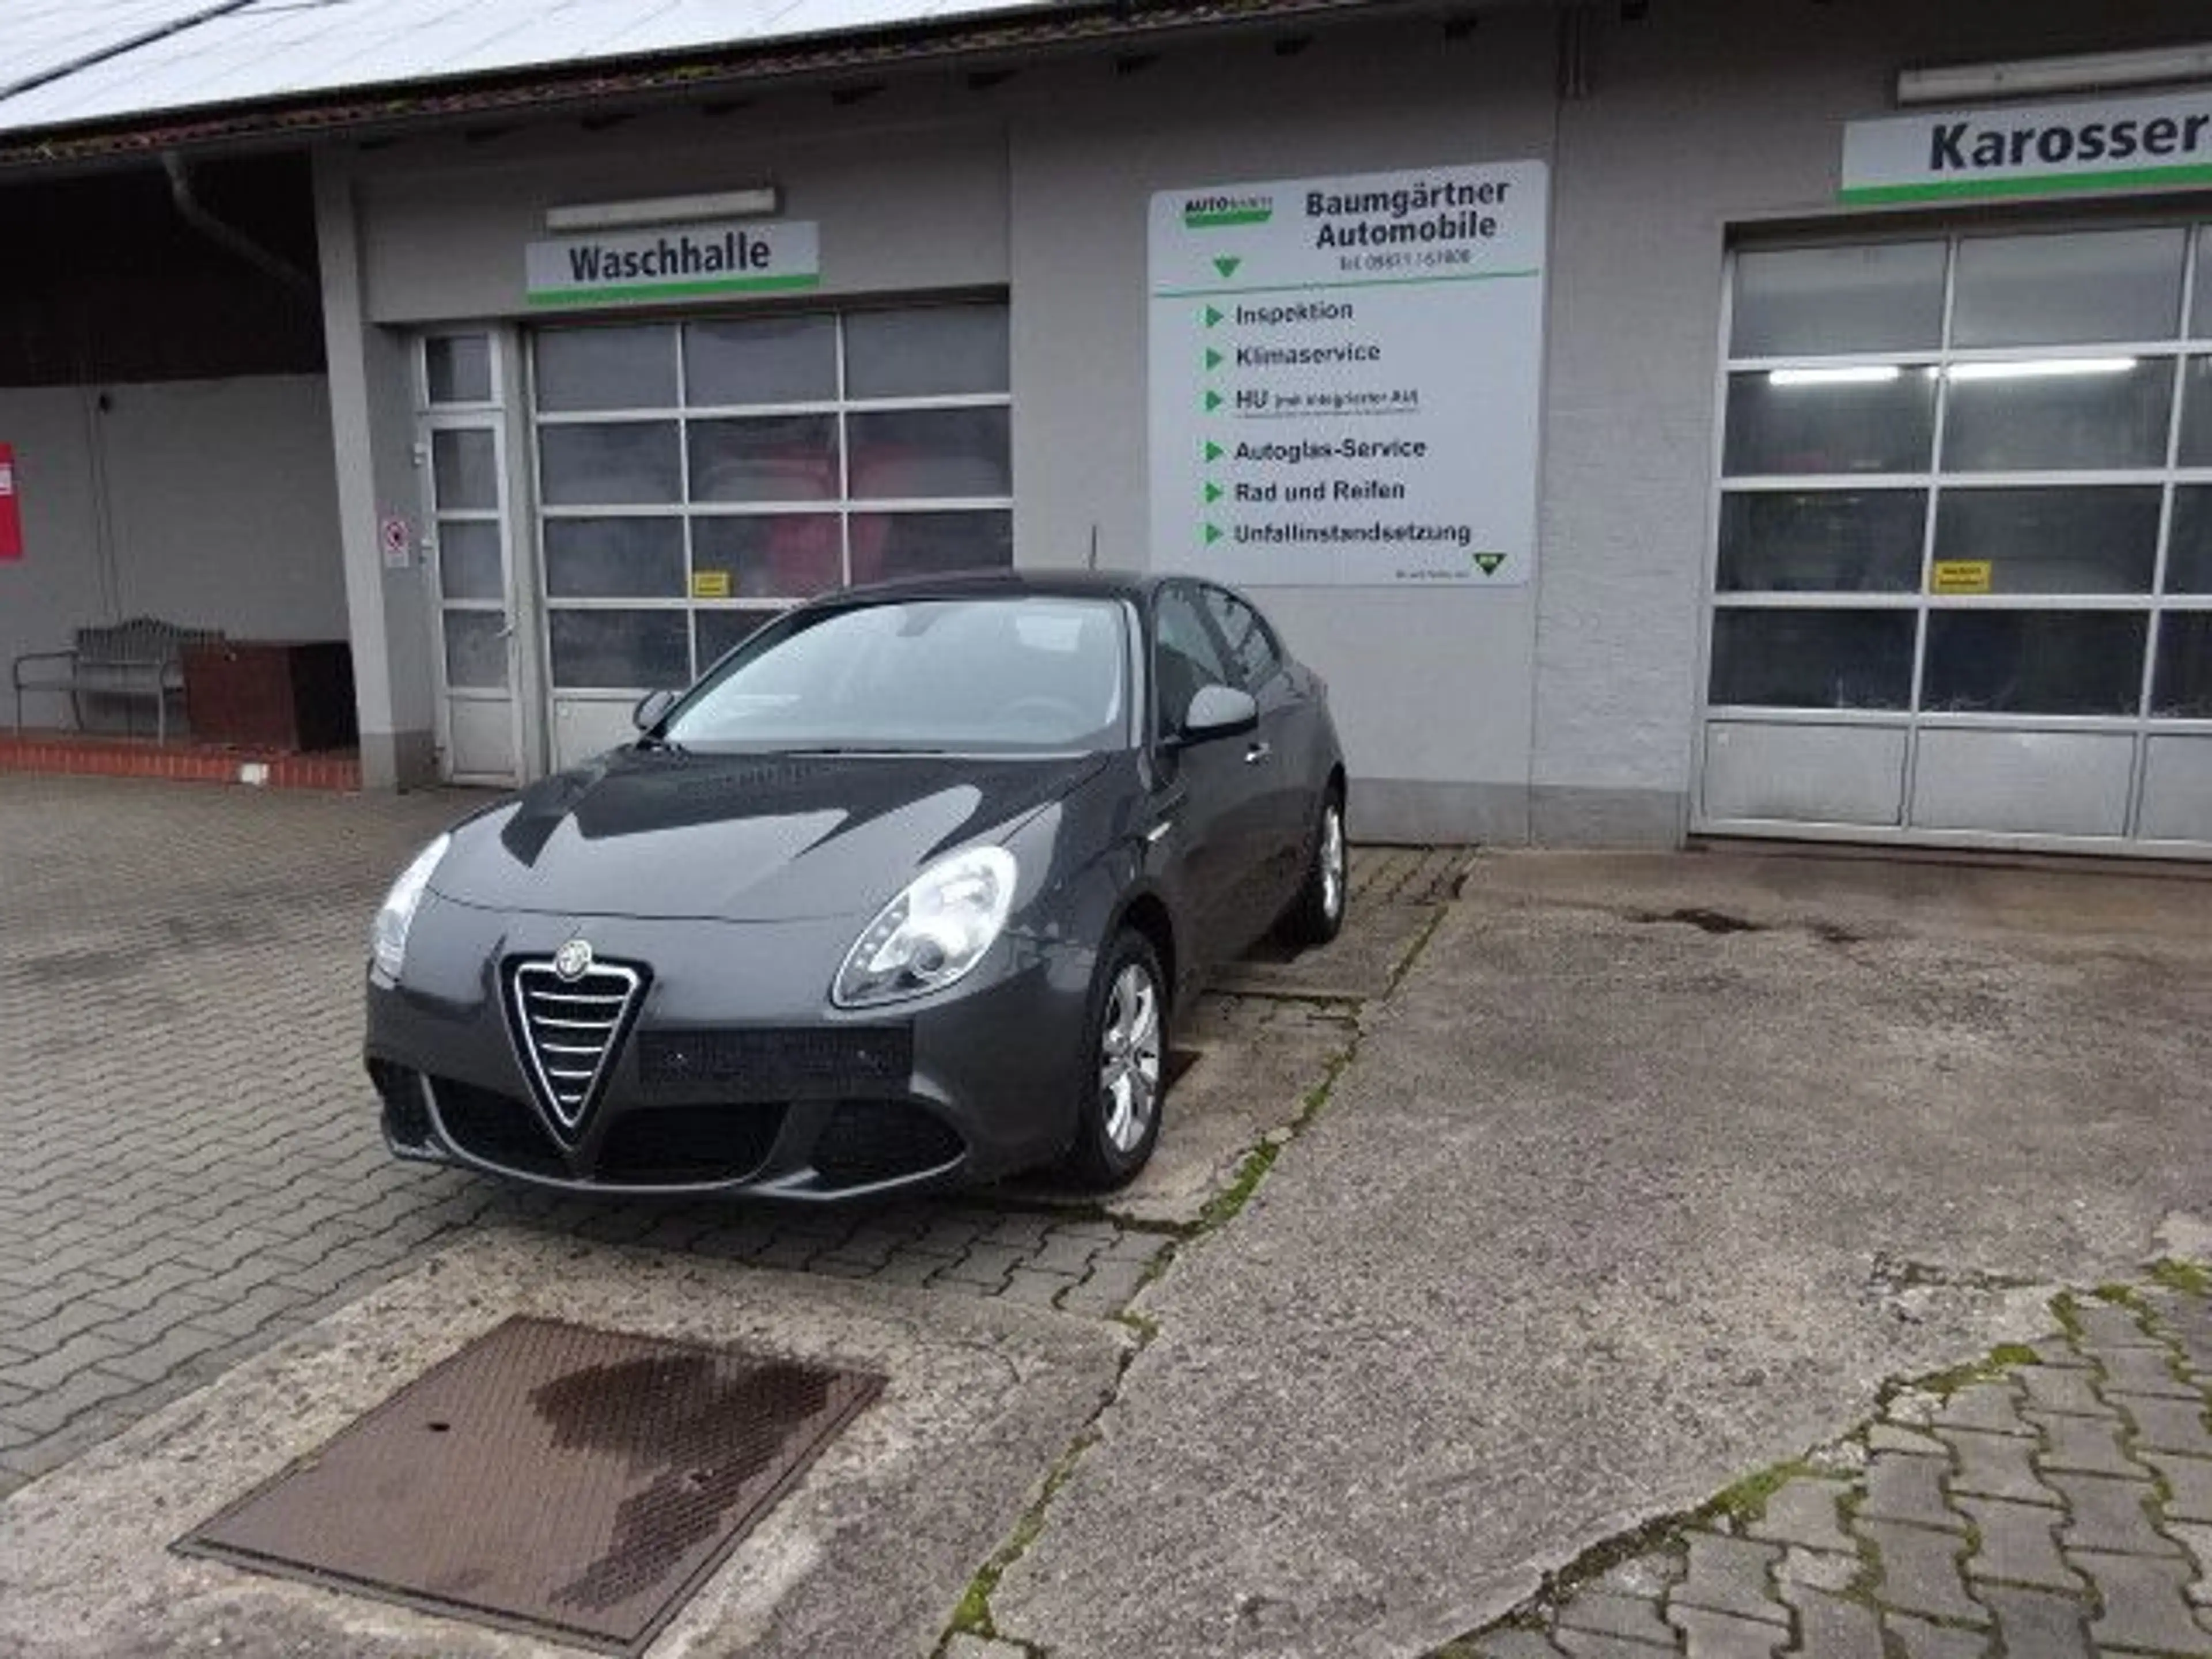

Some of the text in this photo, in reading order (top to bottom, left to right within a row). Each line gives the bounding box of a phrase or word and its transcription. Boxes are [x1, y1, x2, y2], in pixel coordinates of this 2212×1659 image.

[1930, 114, 2210, 171] Karosser
[1306, 181, 1510, 219] Baumgärtner
[1316, 210, 1498, 249] Automobile
[569, 231, 771, 282] Waschhalle
[1236, 301, 1354, 325] Inspektion
[1236, 343, 1382, 367] Klimaservice
[1236, 389, 1269, 408] HU
[1235, 438, 1428, 464] Autoglas-Service
[1236, 479, 1406, 501] Rad und Reifen
[1236, 521, 1471, 546] Unfallinstandsetzung
